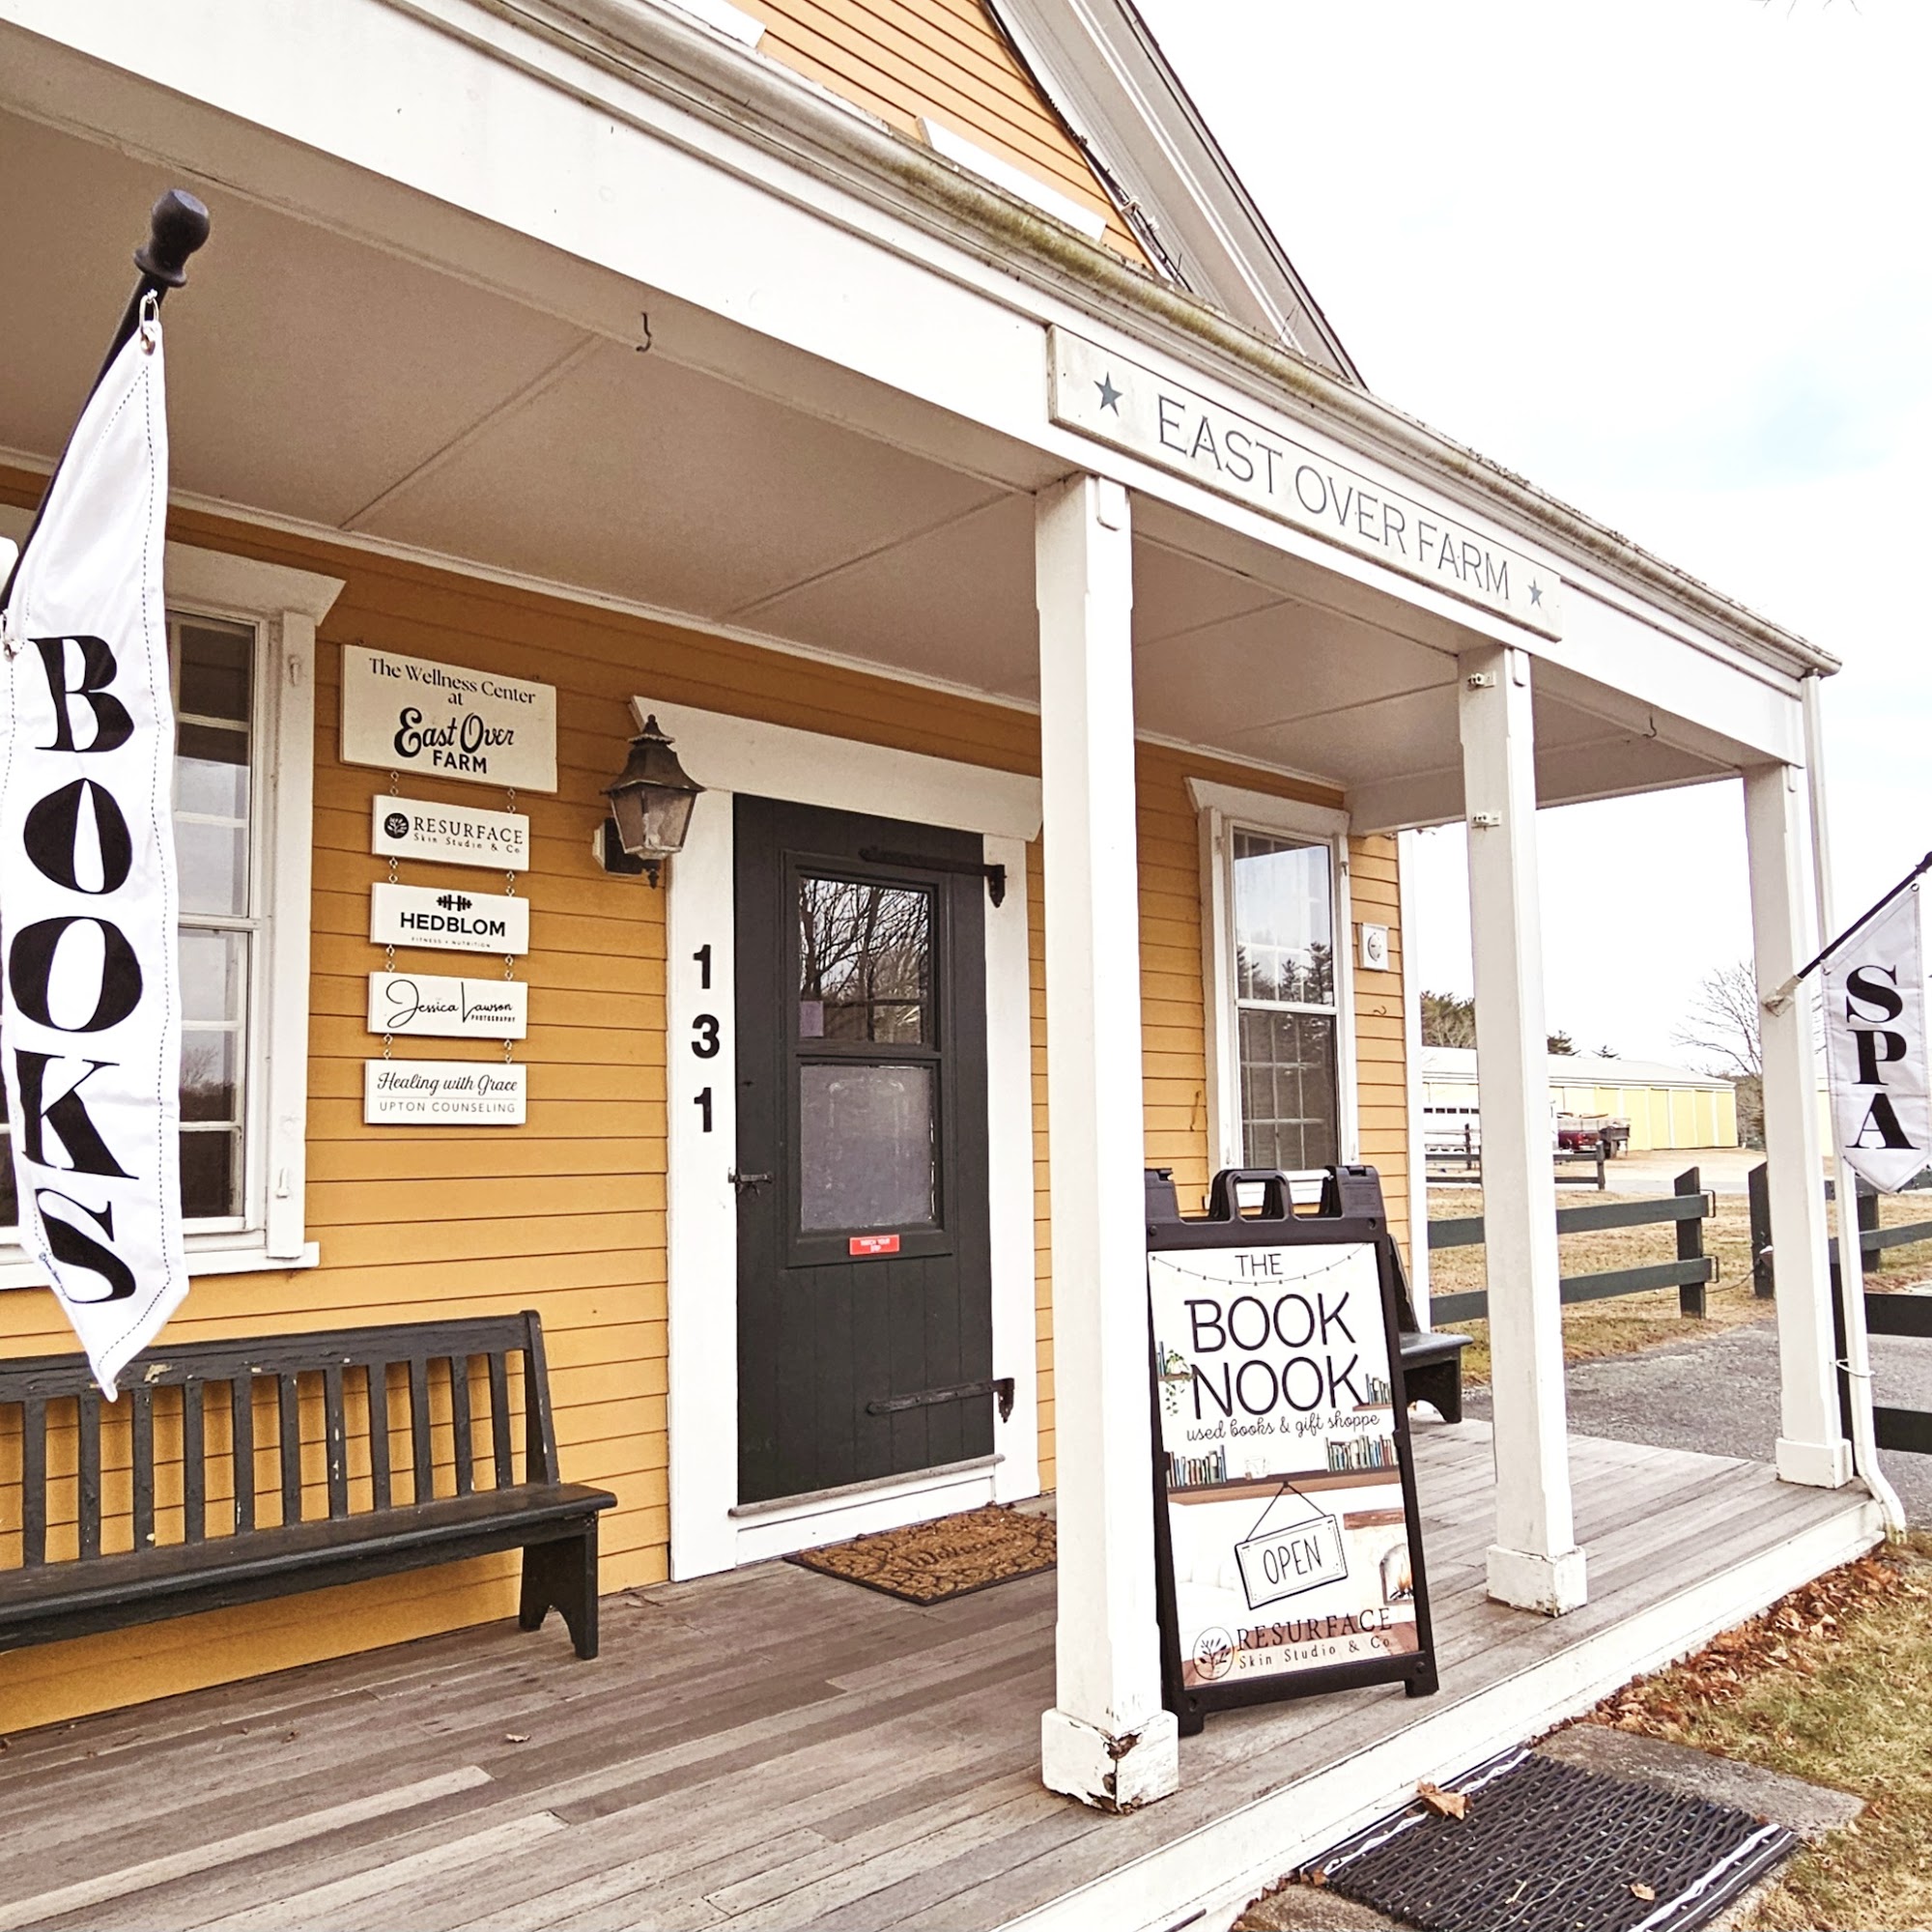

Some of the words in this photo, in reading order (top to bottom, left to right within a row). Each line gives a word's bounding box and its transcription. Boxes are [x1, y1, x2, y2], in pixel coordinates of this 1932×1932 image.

[1158, 394, 1282, 494] EAST
[1295, 464, 1406, 555] OVER
[1418, 519, 1511, 601] FARM
[369, 657, 402, 678] The
[405, 664, 478, 693] Wellness
[481, 680, 536, 704] Center
[447, 693, 464, 706] at
[393, 707, 458, 758] East
[460, 712, 514, 753] Over
[433, 750, 488, 774] FARM
[413, 815, 524, 845] RESURFACE
[413, 834, 438, 843] Skin
[445, 837, 482, 850] Studio
[491, 843, 498, 852] &
[506, 844, 521, 854] Co
[400, 911, 506, 937] HEDBLOM
[9, 635, 144, 1305] BOOKS
[385, 979, 458, 1029] Jessica
[461, 981, 513, 1024] Lawson
[691, 944, 721, 1133] 131
[1845, 964, 1921, 1151] SPA
[377, 1071, 440, 1096] Healing
[443, 1075, 475, 1092] with
[477, 1074, 518, 1097] Grace
[380, 1101, 425, 1113] UPTON
[432, 1102, 516, 1114] COUNSELING
[1235, 1253, 1284, 1277] THE
[1183, 1291, 1356, 1353] BOOK
[1190, 1353, 1370, 1420] NOOK
[1186, 1420, 1227, 1441] used
[1230, 1417, 1275, 1437] books
[1279, 1418, 1292, 1434] &
[1294, 1414, 1323, 1435] gift
[1327, 1409, 1380, 1433] shoppe
[1263, 1535, 1322, 1585] OPEN
[1236, 1607, 1393, 1652] RESURFACE
[1239, 1656, 1273, 1670] Skin
[1284, 1645, 1337, 1663] Studio
[1349, 1640, 1360, 1653] &
[1371, 1635, 1391, 1649] Co
